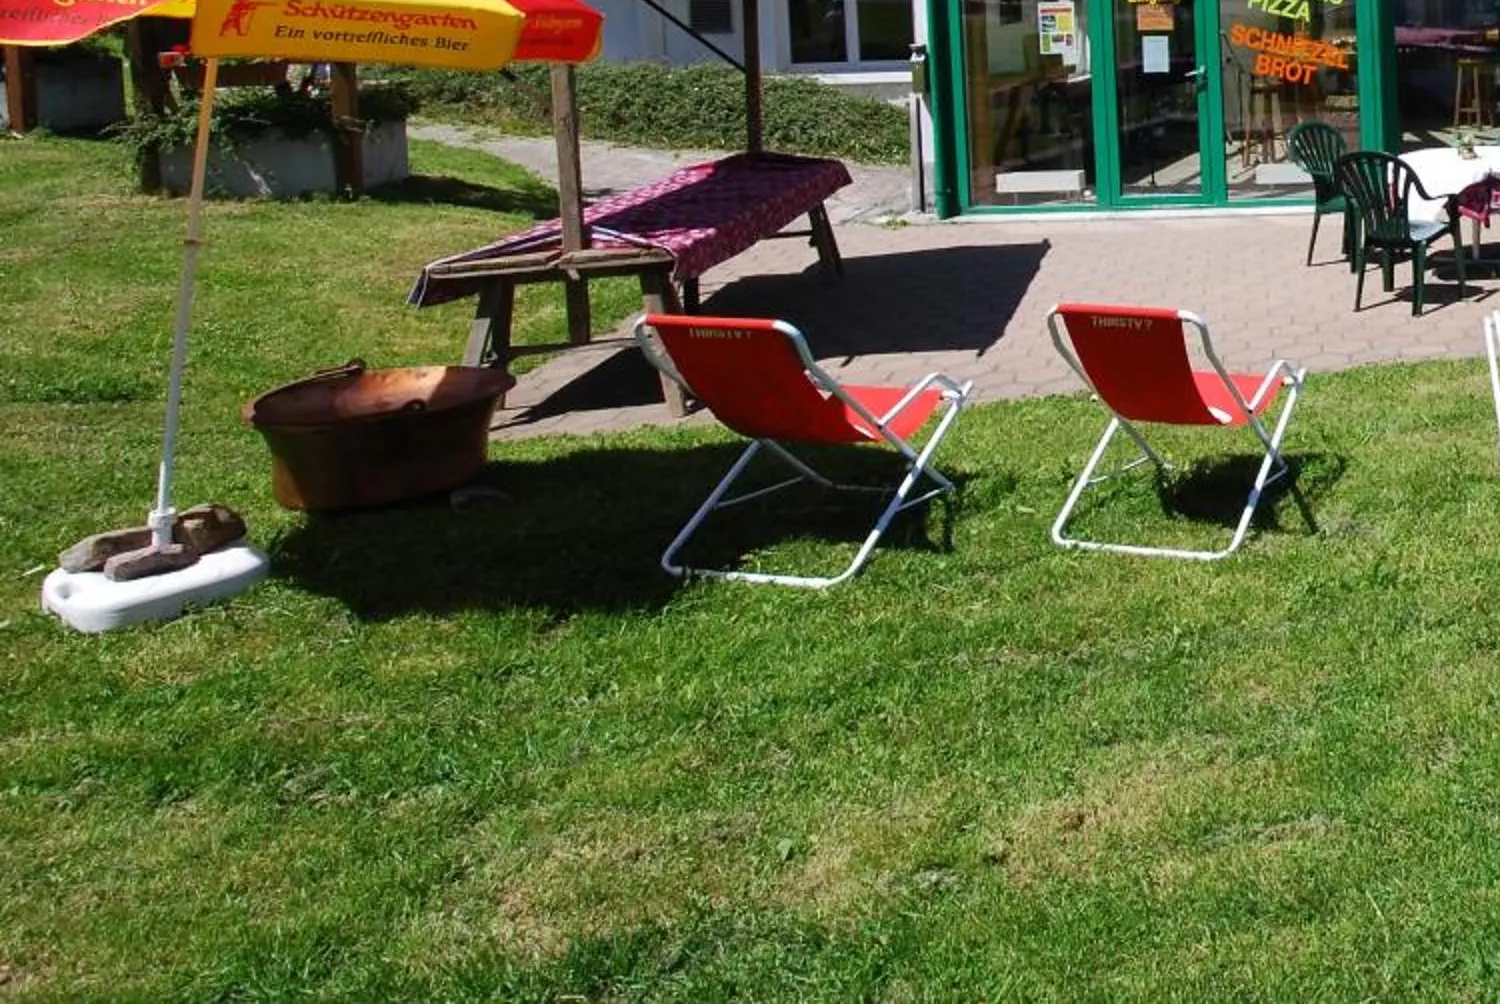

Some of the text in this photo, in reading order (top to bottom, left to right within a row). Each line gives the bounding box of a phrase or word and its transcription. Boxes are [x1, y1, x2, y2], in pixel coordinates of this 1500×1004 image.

[274, 24, 471, 52] Ein vortreffliches Bier
[1255, 53, 1319, 86] BROT
